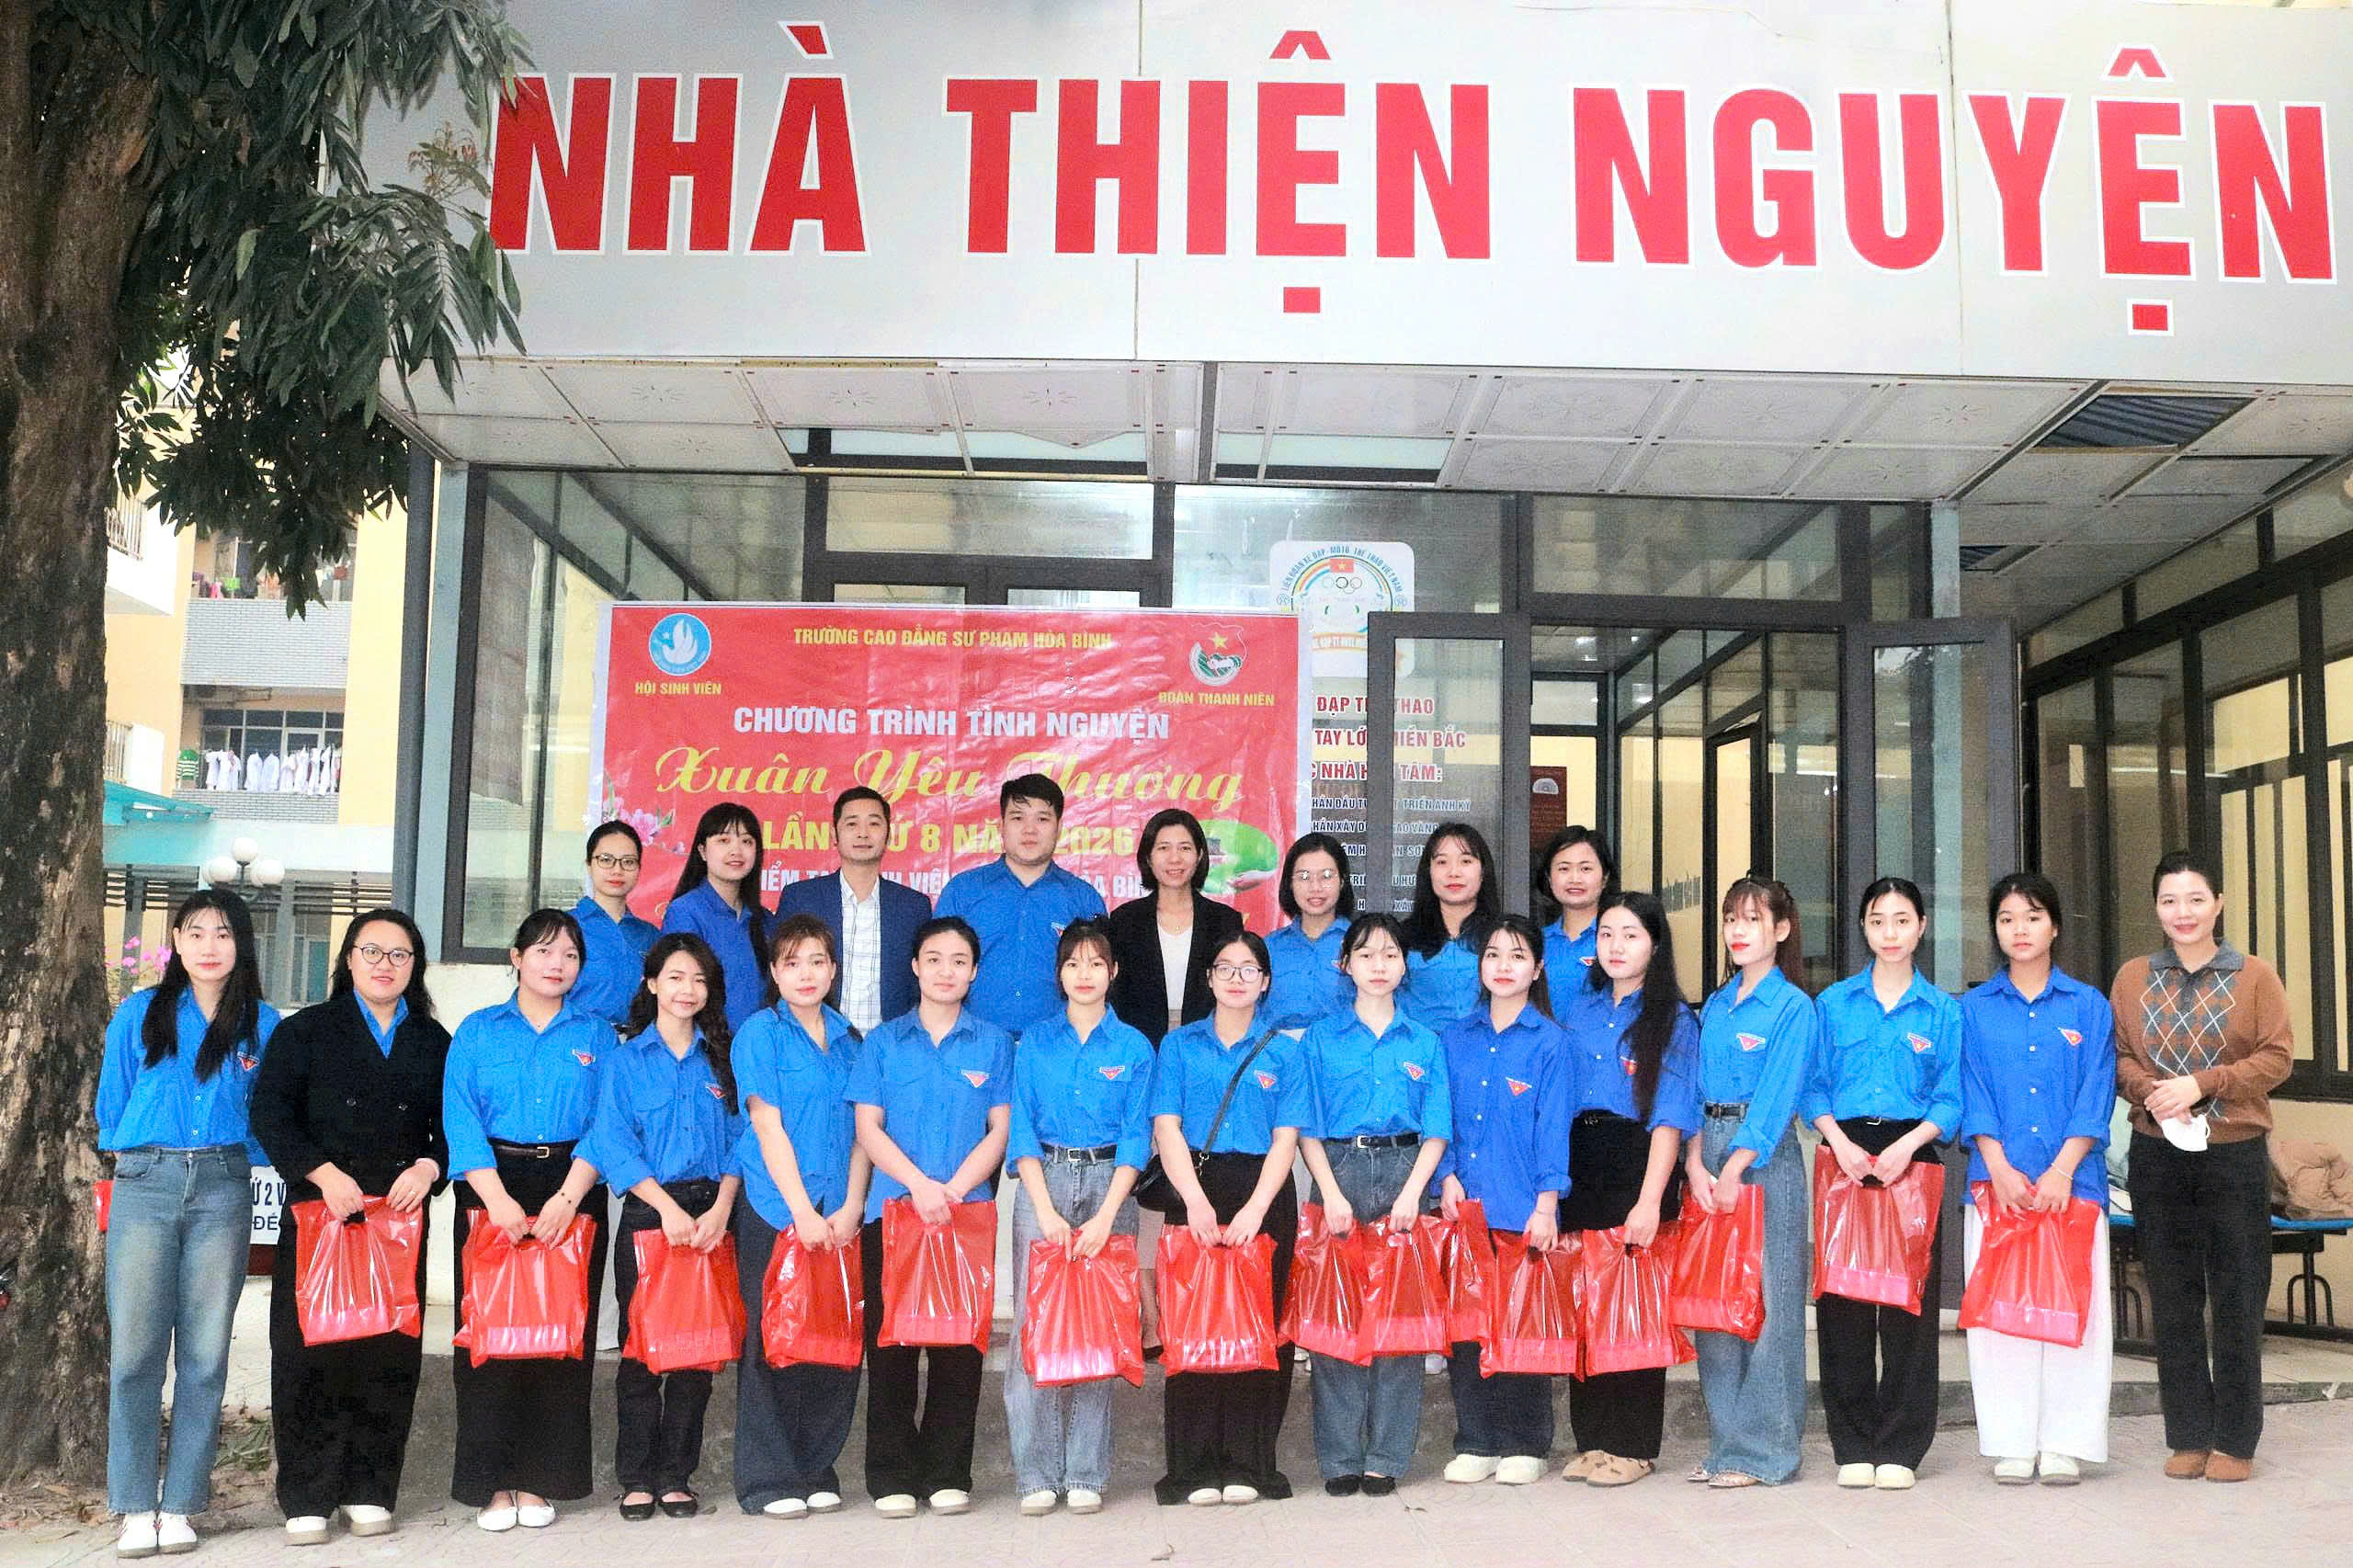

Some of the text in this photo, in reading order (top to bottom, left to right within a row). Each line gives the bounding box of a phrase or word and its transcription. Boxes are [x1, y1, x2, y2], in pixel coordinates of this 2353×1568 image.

[487, 23, 2336, 332] NHÀ THIỆN NGUYỆN
[793, 624, 858, 645] TRƯỜNG
[863, 629, 897, 646] CAO
[952, 630, 977, 648] SƯ
[634, 680, 722, 697] HỘI SINH VIÊN
[1198, 692, 1240, 706] THANH
[1244, 691, 1276, 707] NIÊN
[1316, 696, 1350, 716] ĐẠP
[734, 705, 857, 733] CHƯƠNG
[868, 705, 957, 736] TRÌNH
[1046, 707, 1170, 745] NGUYỆN
[1314, 729, 1342, 746] TAY
[1347, 724, 1368, 745] LỚ
[655, 746, 1245, 812] Xuân Yêu Thương
[1322, 759, 1356, 780] NHÀ
[763, 811, 831, 852] LẦN
[922, 823, 941, 853] 8
[954, 818, 1002, 854] NĂ
[761, 859, 801, 892] IỂM
[265, 1182, 273, 1206] 2
[277, 1182, 287, 1206] V
